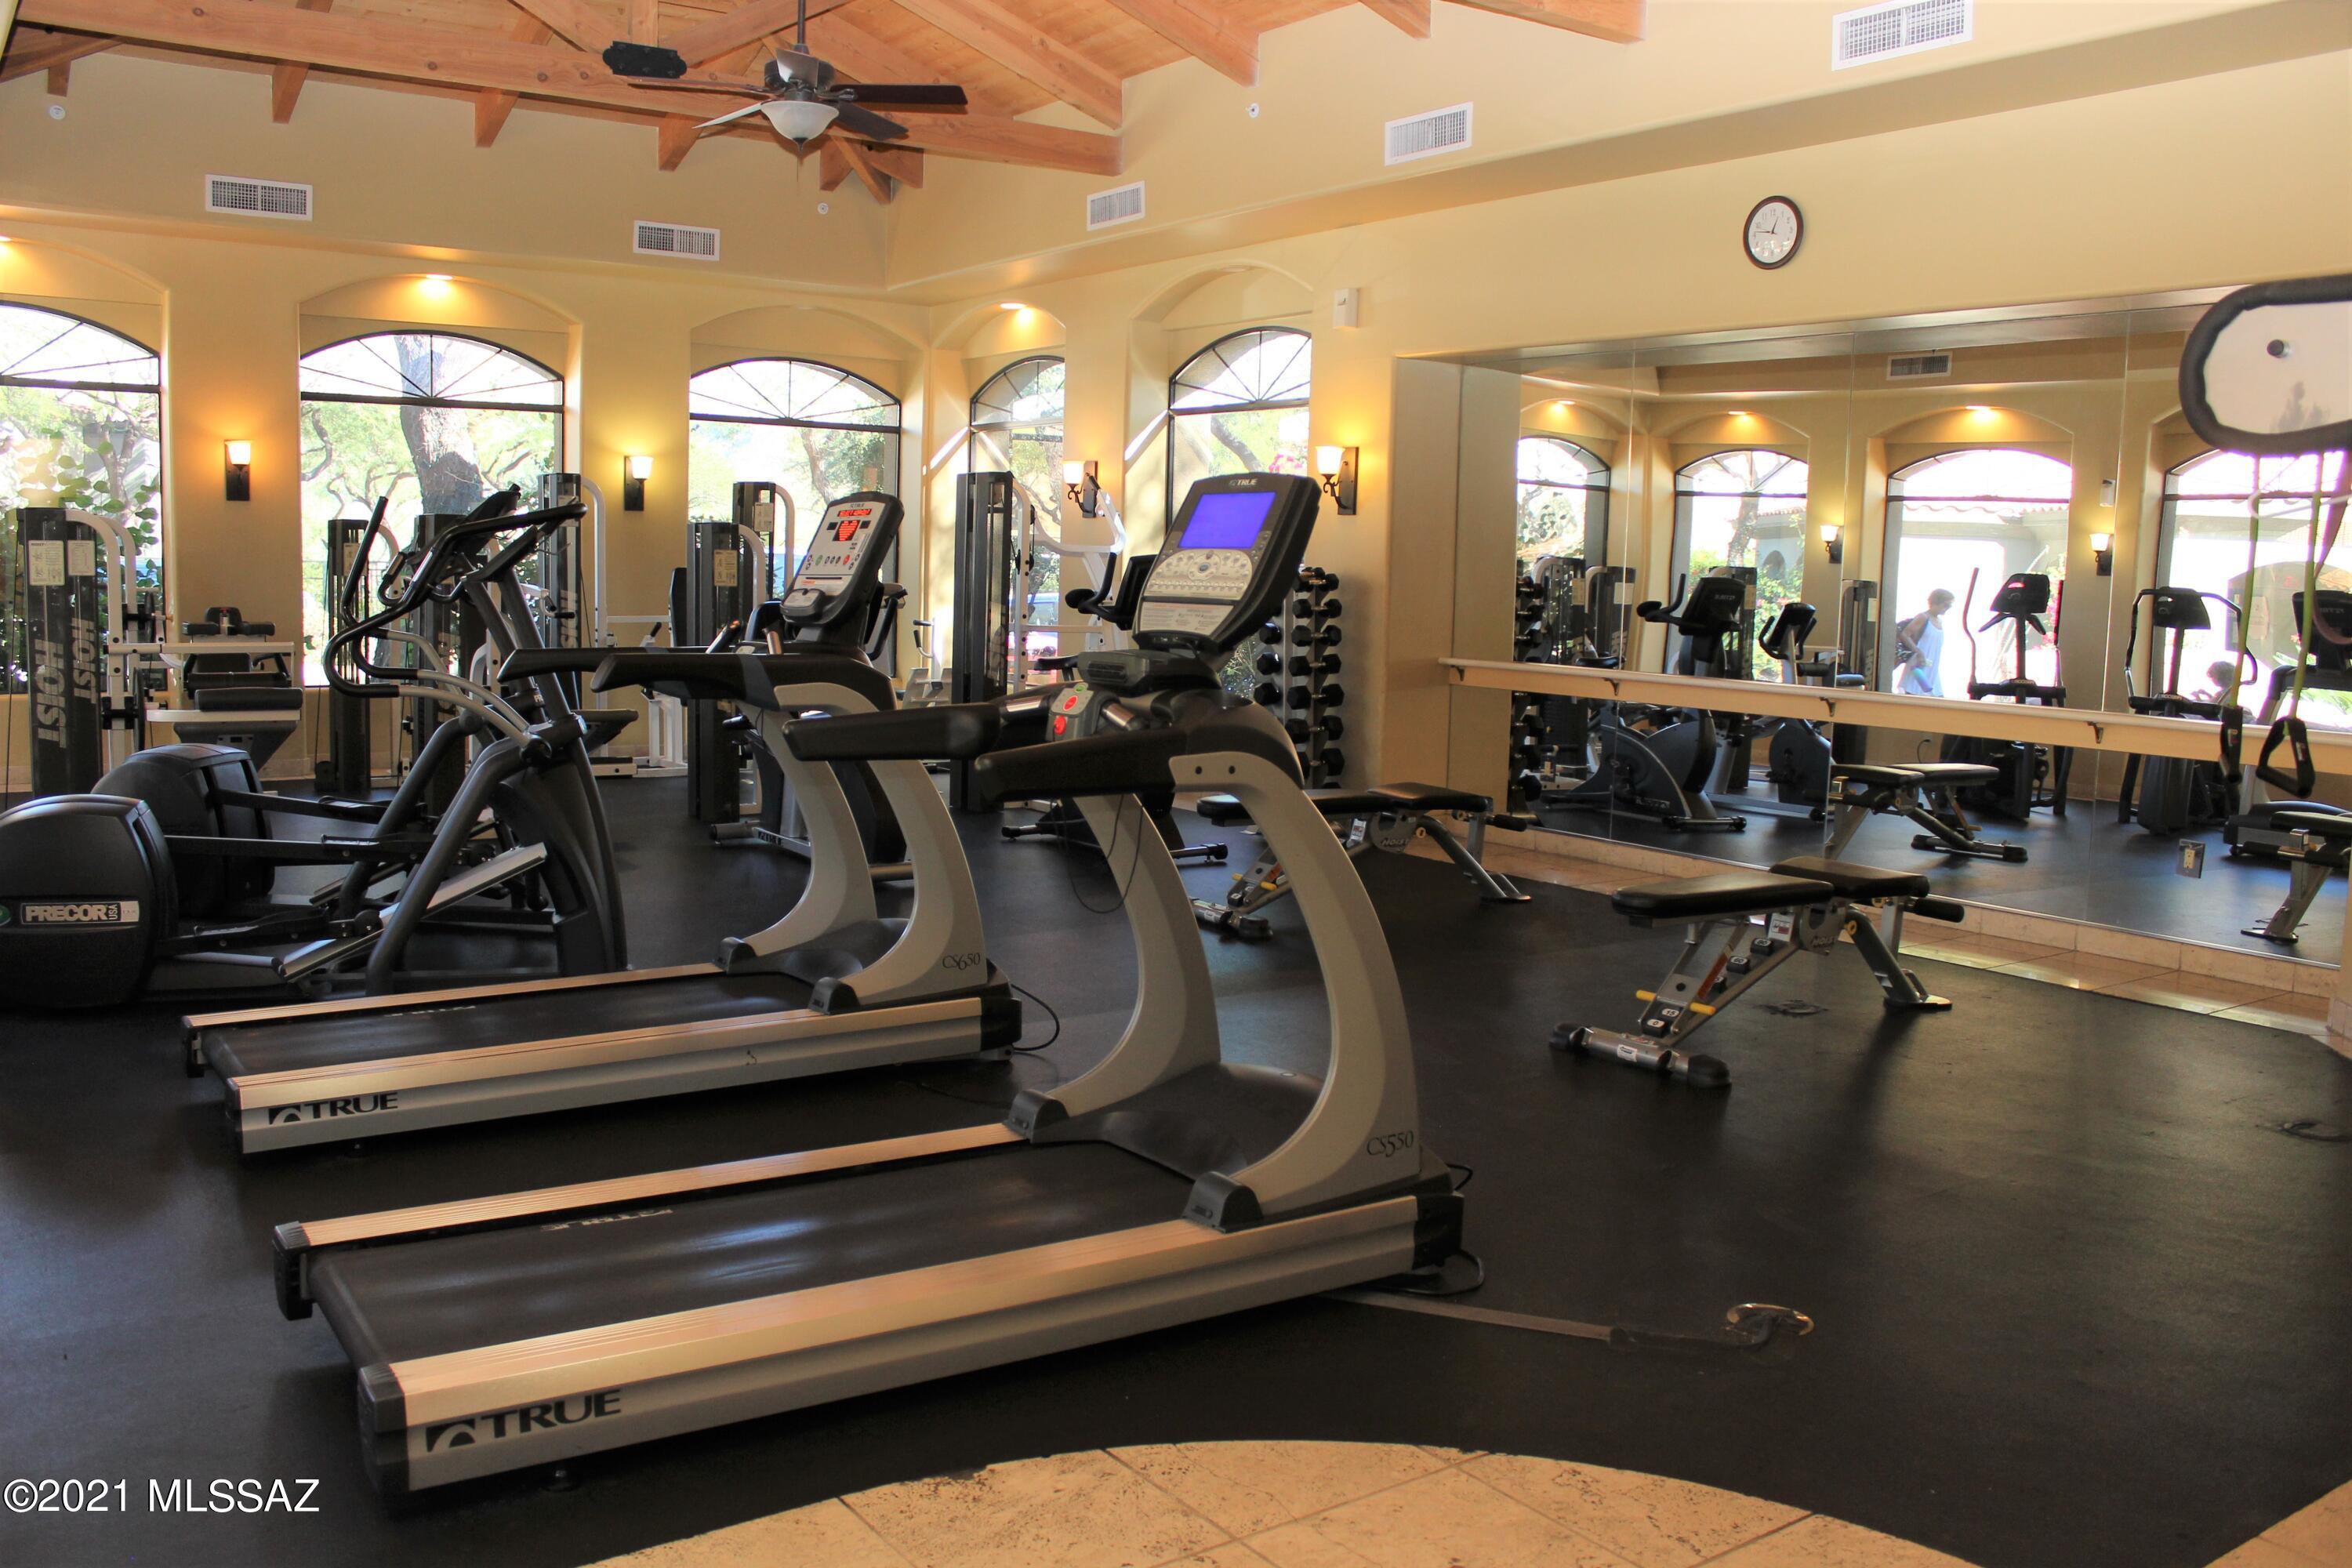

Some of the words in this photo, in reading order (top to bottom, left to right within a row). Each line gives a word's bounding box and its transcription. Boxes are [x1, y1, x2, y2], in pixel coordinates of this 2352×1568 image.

[71, 617, 97, 704] HOIST
[34, 638, 67, 749] HOIST
[26, 904, 108, 922] PRECOR
[108, 904, 118, 920] USA
[942, 952, 981, 971] CS650
[304, 1092, 398, 1120] TRUE
[1367, 1130, 1414, 1158] CS550
[481, 1388, 622, 1439] TRUE
